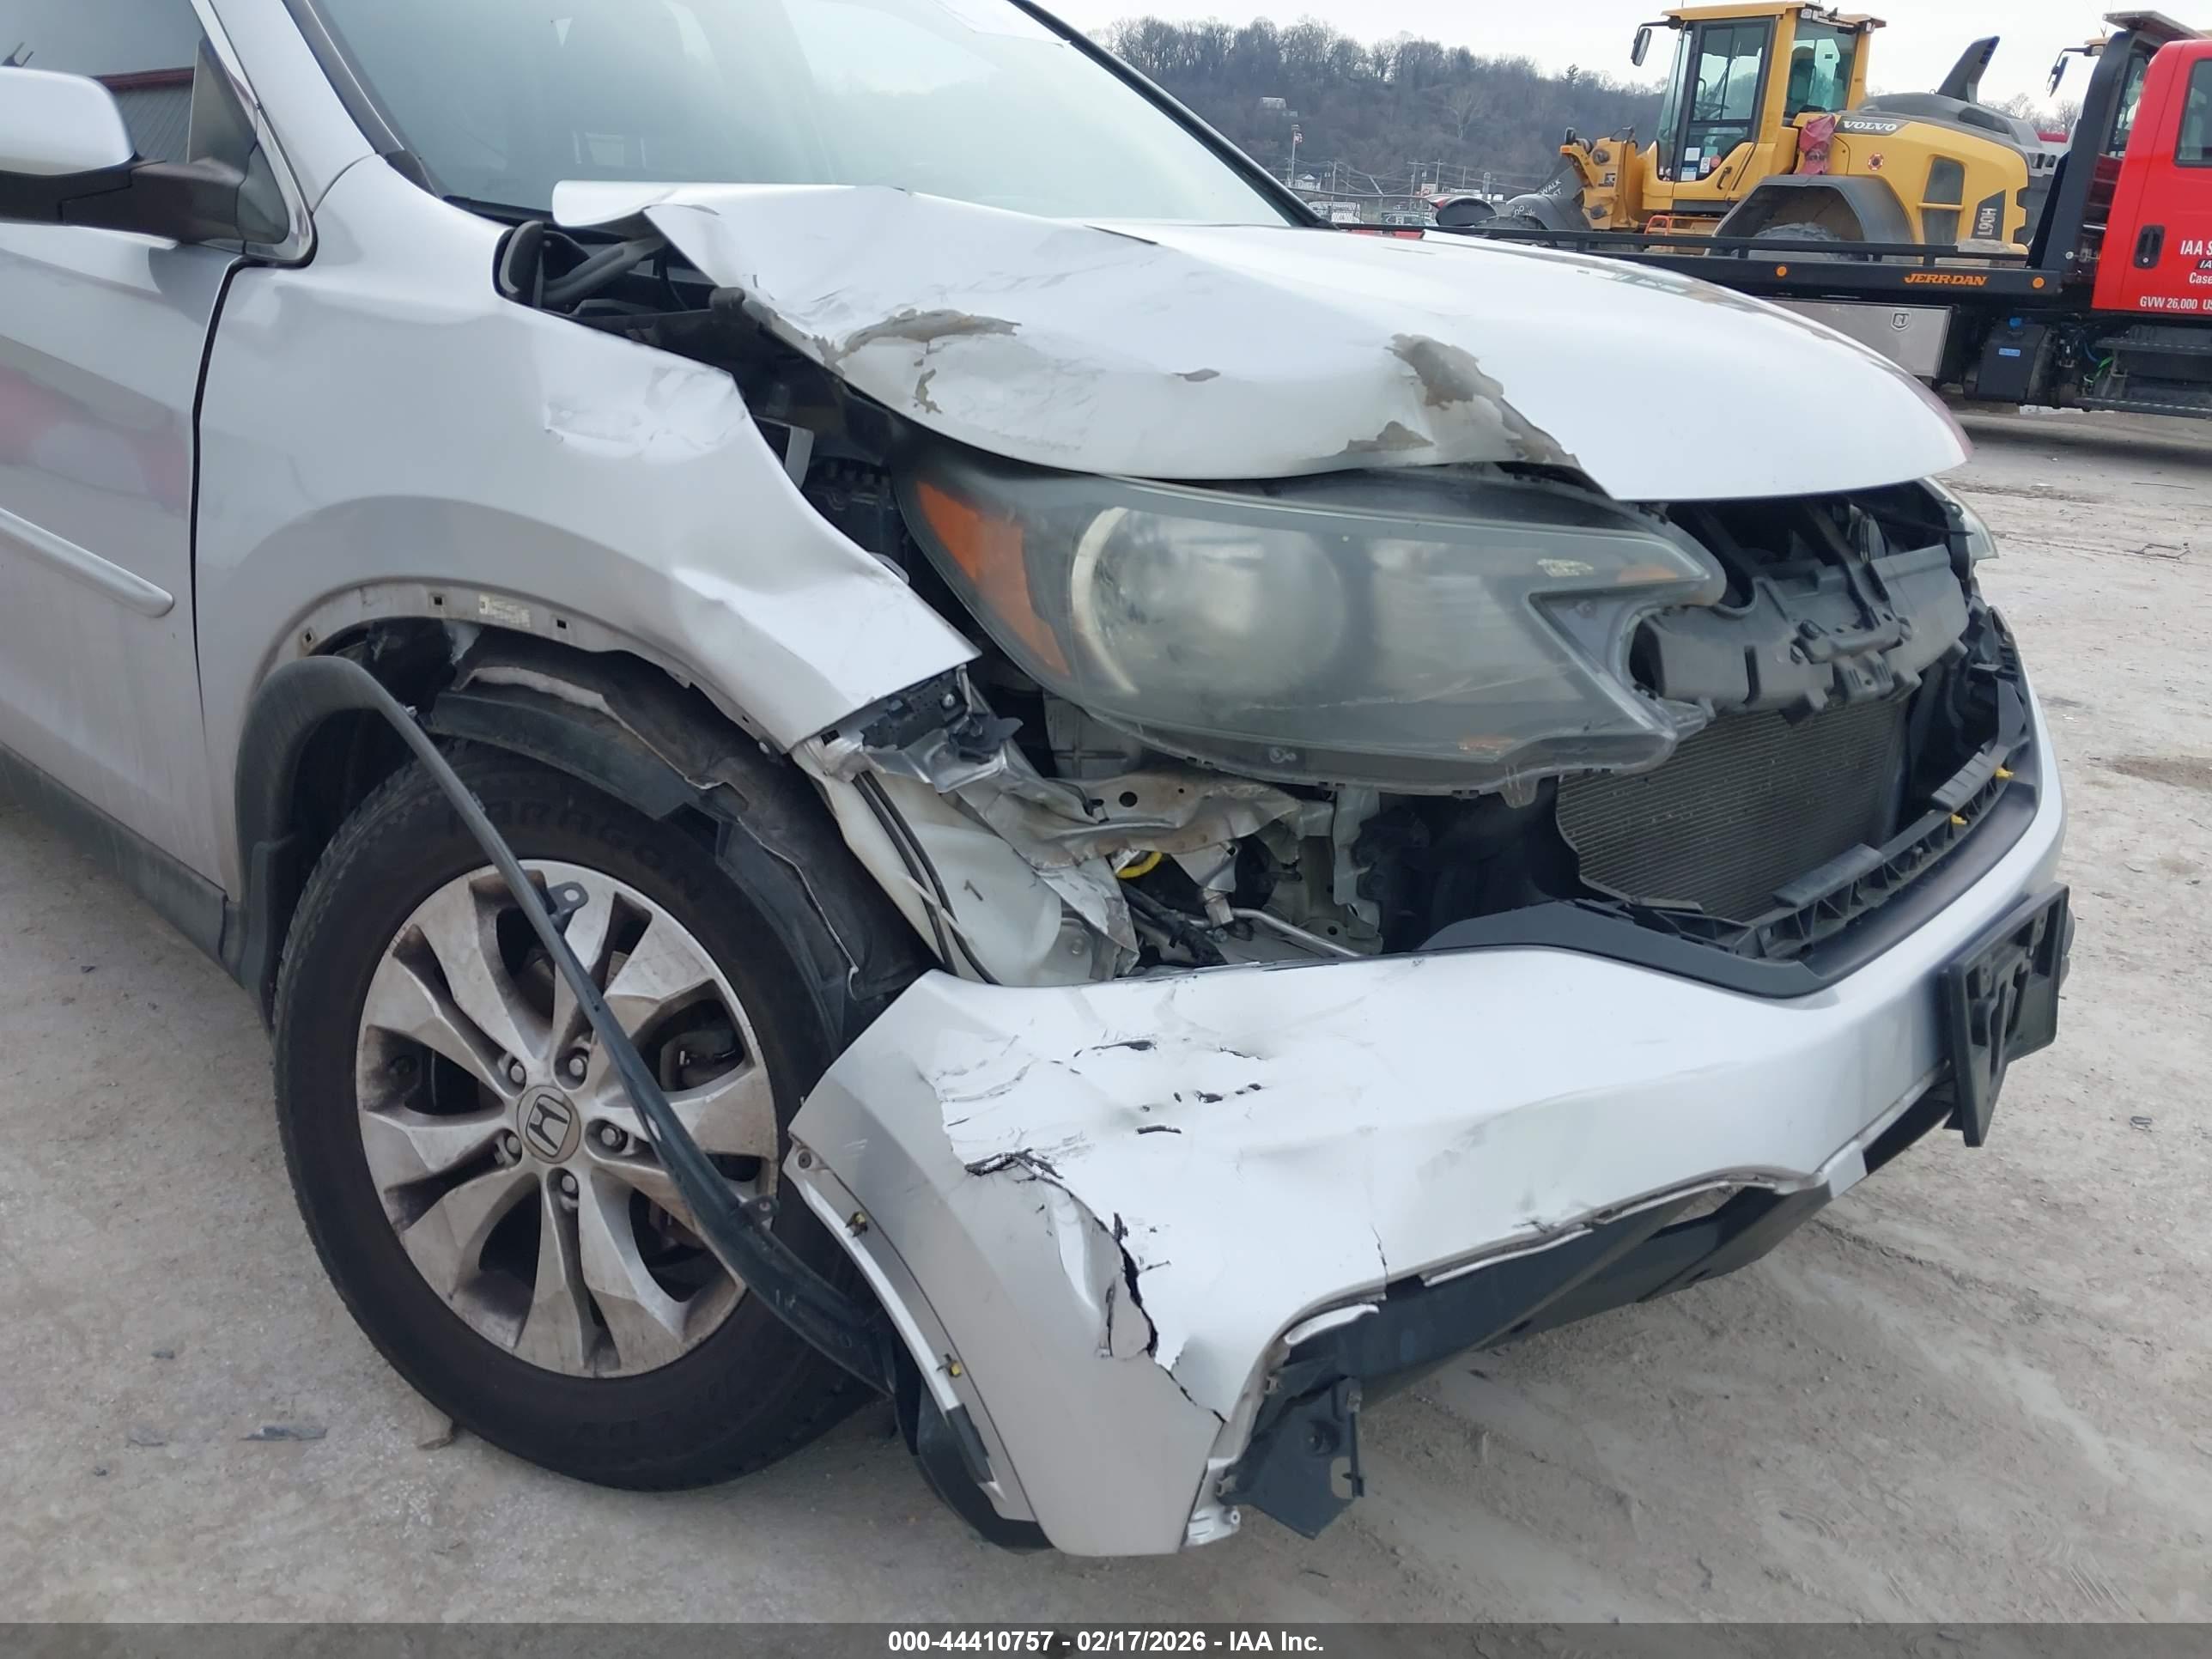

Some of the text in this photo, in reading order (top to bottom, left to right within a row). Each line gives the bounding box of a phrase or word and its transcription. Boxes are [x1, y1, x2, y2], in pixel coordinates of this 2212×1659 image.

[1843, 120, 1897, 131] VOLVO
[1977, 208, 1997, 236] L90H
[2179, 240, 2203, 256] IAA
[2140, 295, 2166, 308] GVW
[2166, 298, 2198, 310] 26,000
